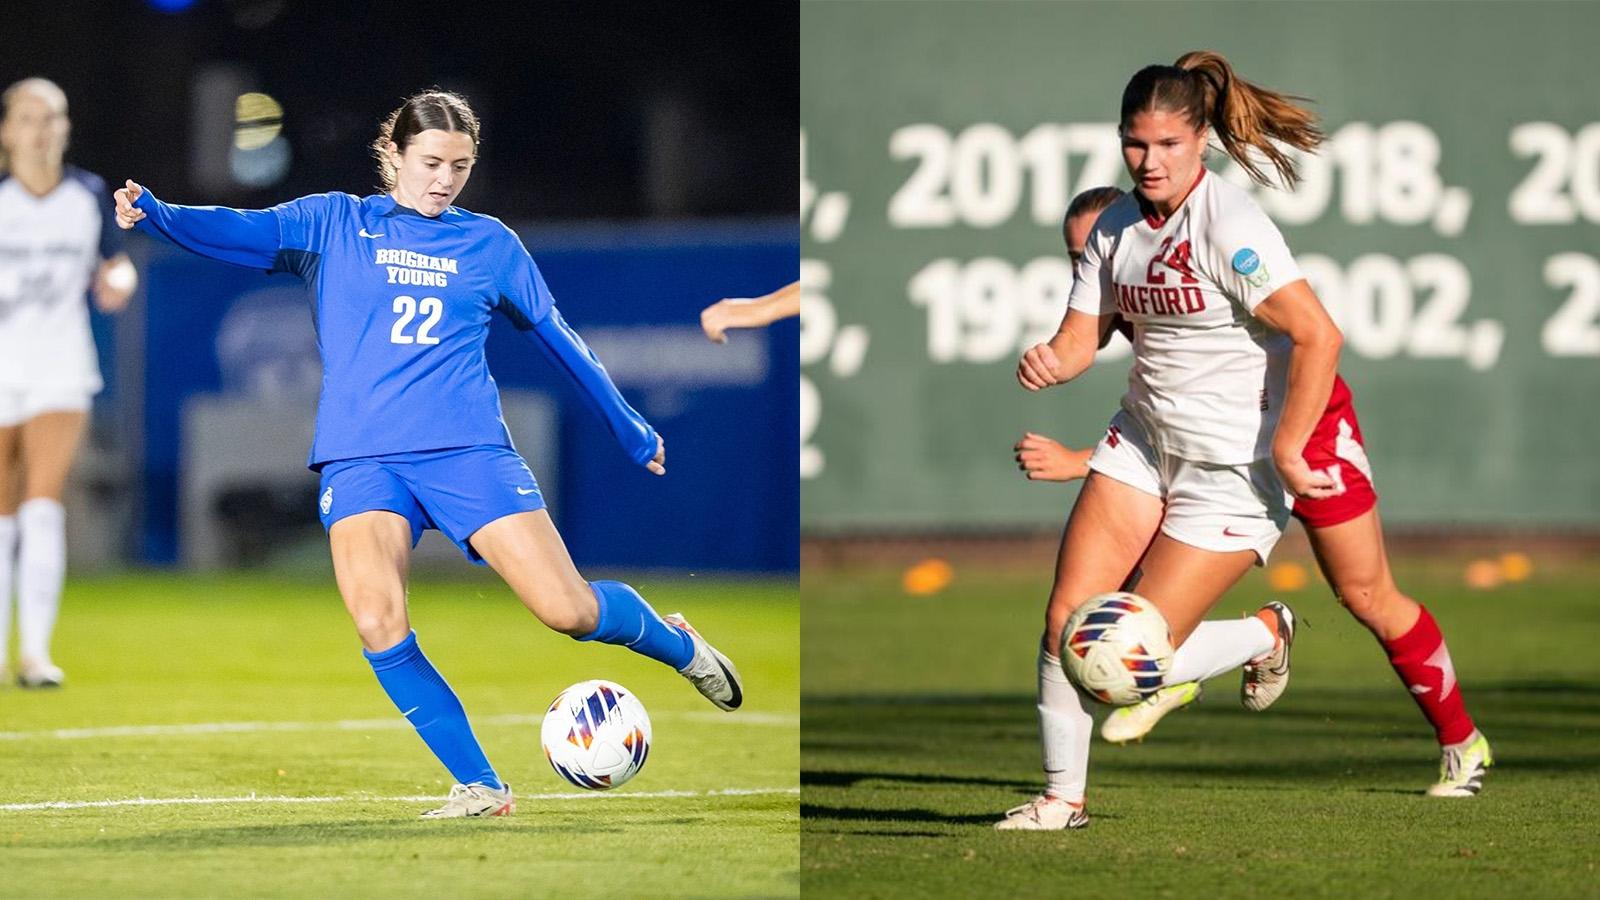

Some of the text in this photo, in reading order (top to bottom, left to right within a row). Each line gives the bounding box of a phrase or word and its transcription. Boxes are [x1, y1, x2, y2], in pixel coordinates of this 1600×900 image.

[1222, 121, 1472, 238] 018,
[375, 248, 458, 274] BRIGHAM
[386, 266, 448, 287] YOUNG
[390, 295, 444, 345] 22
